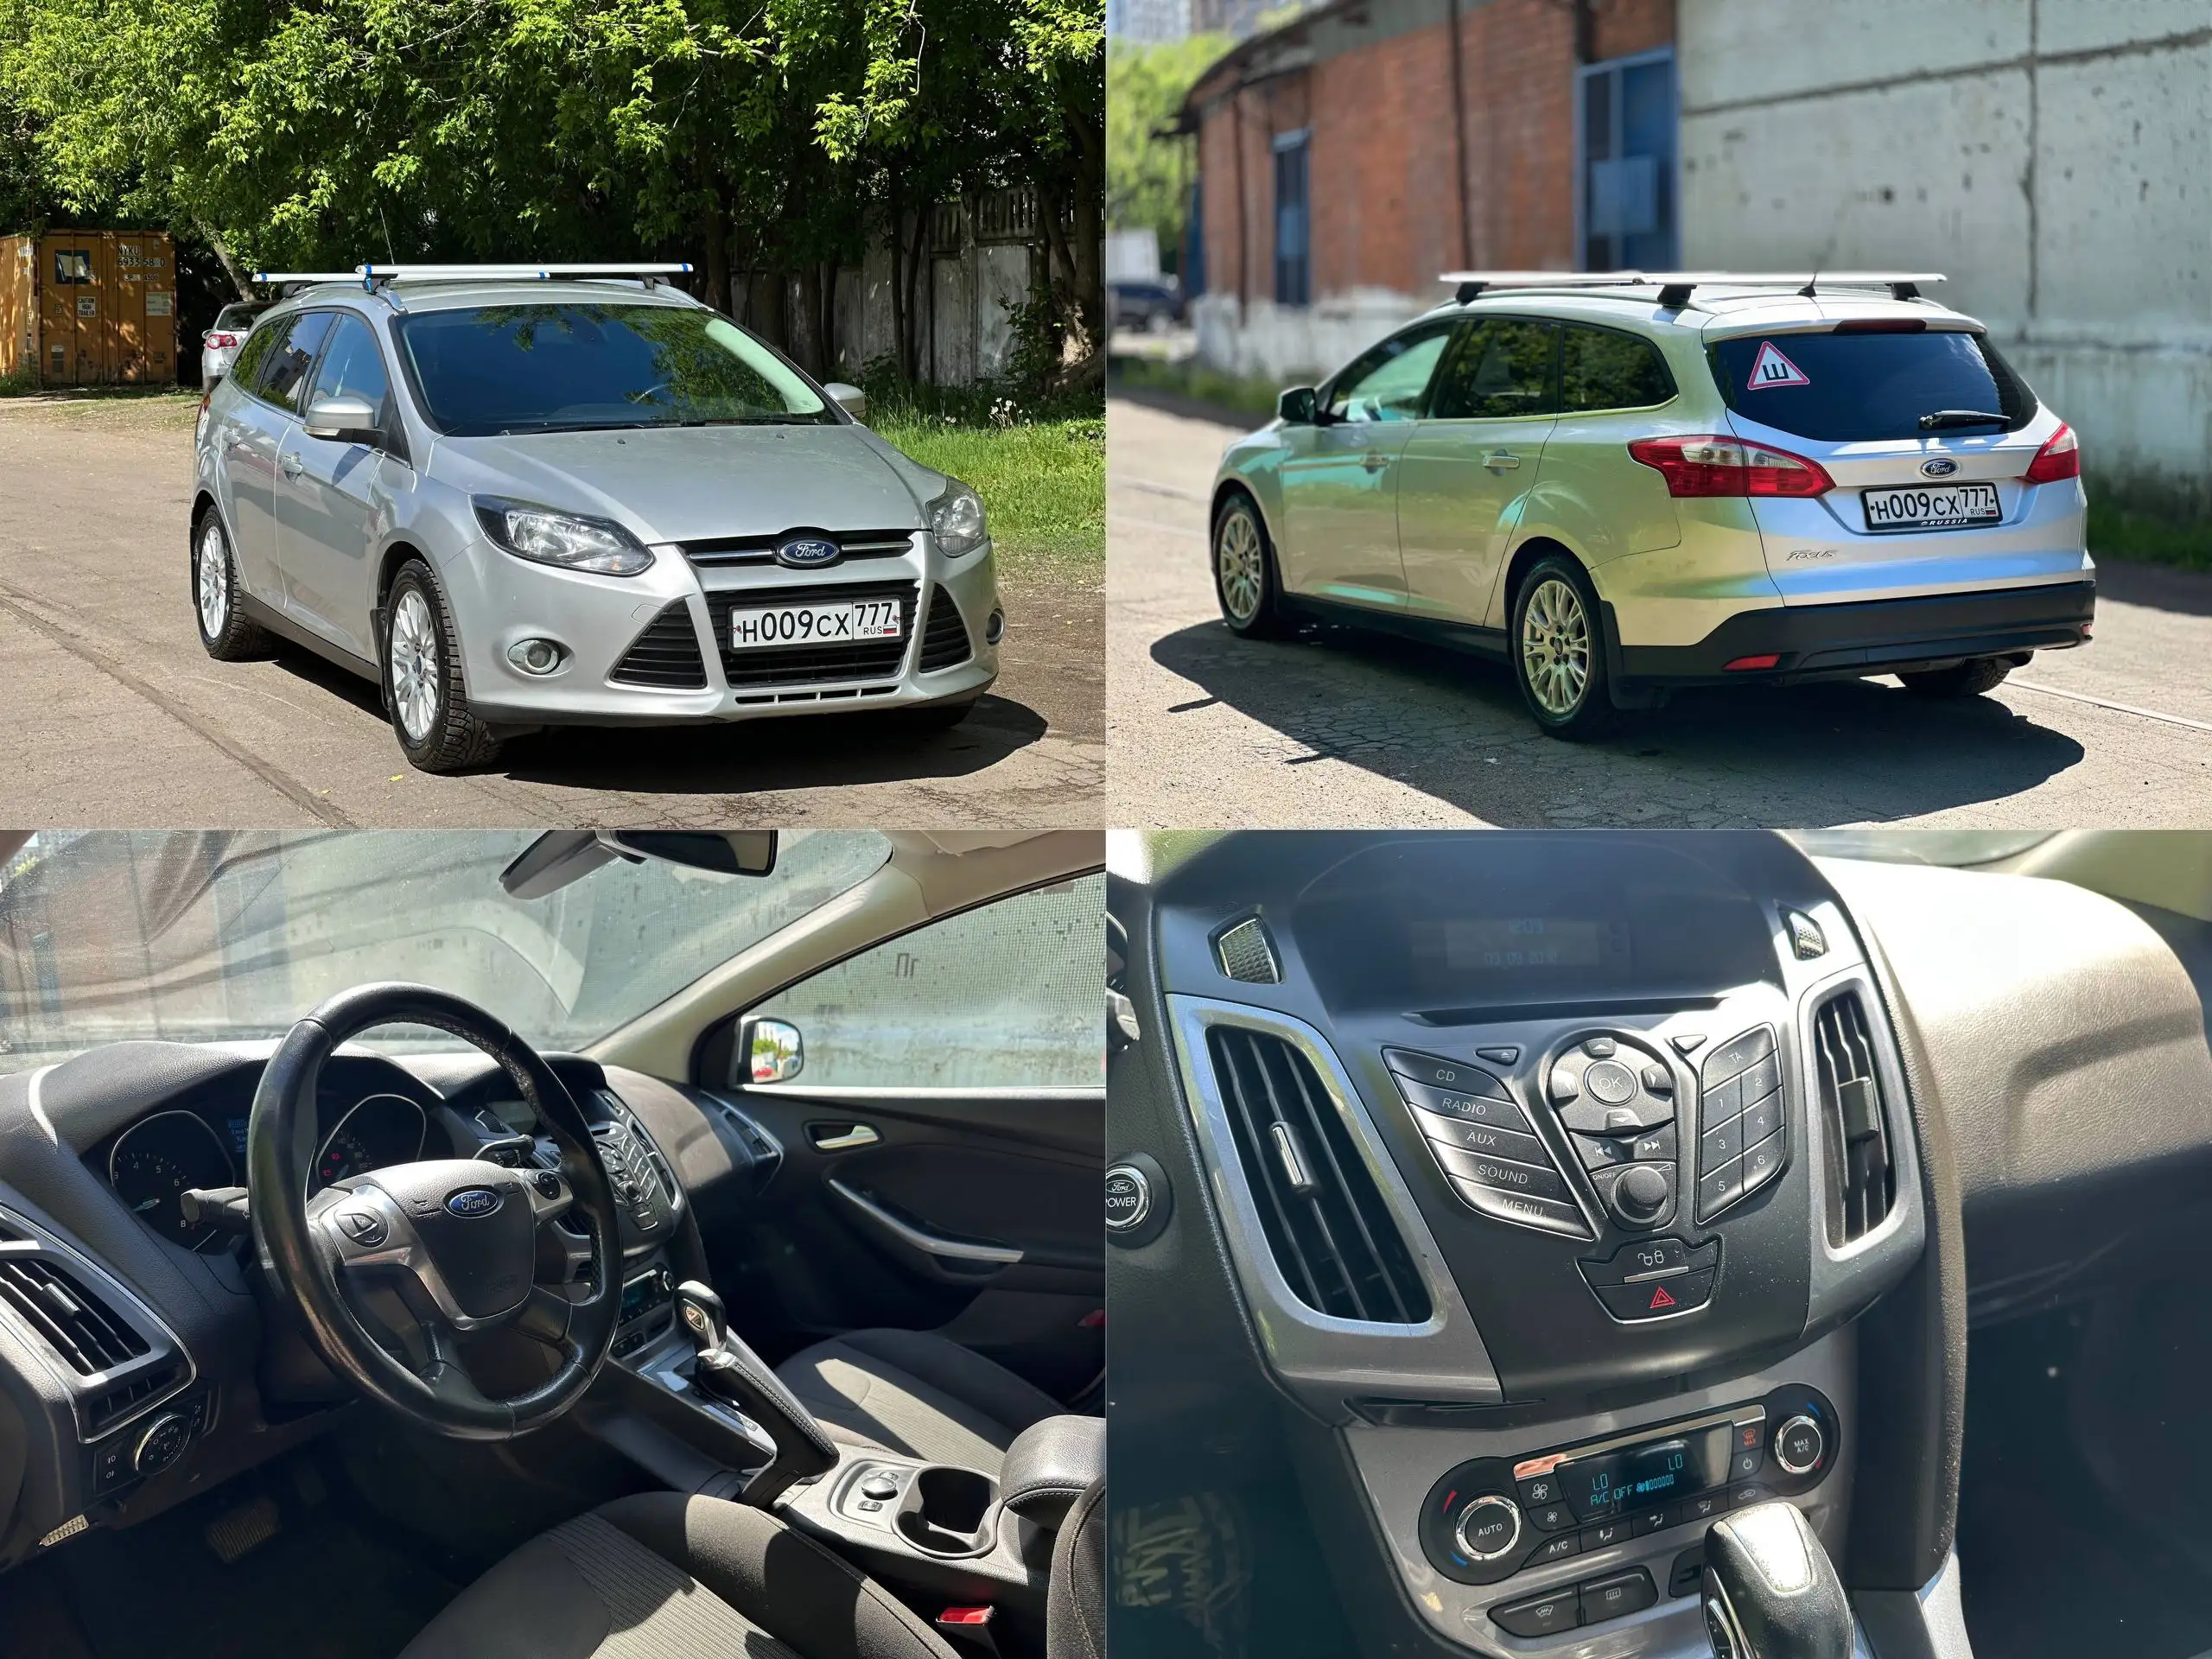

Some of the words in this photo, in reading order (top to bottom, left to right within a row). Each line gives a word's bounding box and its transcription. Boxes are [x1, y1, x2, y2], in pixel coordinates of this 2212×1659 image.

[118, 245, 139, 256] NYKU
[1762, 362, 1789, 381] Ш
[1930, 462, 1951, 474] Ford
[1959, 488, 1988, 508] 777
[1970, 507, 1986, 516] RUS
[1929, 518, 1968, 526] RUSSIA
[795, 543, 826, 557] Ford
[855, 602, 893, 627] 777
[863, 626, 883, 636] RUS
[1729, 1052, 1744, 1065] TA
[1435, 1069, 1456, 1082] CD
[1755, 1077, 1763, 1087] 2
[1599, 1077, 1622, 1090] OK
[1441, 1097, 1486, 1116] RADIO
[1719, 1099, 1724, 1108] 1
[1758, 1116, 1764, 1126] 4
[1466, 1131, 1497, 1147] AUX
[1719, 1140, 1726, 1149] 3
[1758, 1155, 1765, 1165] 6
[1478, 1164, 1529, 1185] SOUND
[1592, 1172, 1617, 1180] ON/OFF
[1111, 1182, 1130, 1192] Ford
[1719, 1180, 1726, 1192] 5
[460, 1193, 490, 1211] Ford
[1106, 1197, 1137, 1208] OWER
[1502, 1198, 1543, 1217] MENU
[1794, 1438, 1809, 1447] MAX
[1668, 1453, 1683, 1471] LO
[1592, 1473, 1608, 1491] LO
[1590, 1491, 1611, 1507] A/C
[1614, 1484, 1633, 1500] OFF
[1478, 1522, 1503, 1537] AUTO
[1548, 1540, 1569, 1554] A/C
